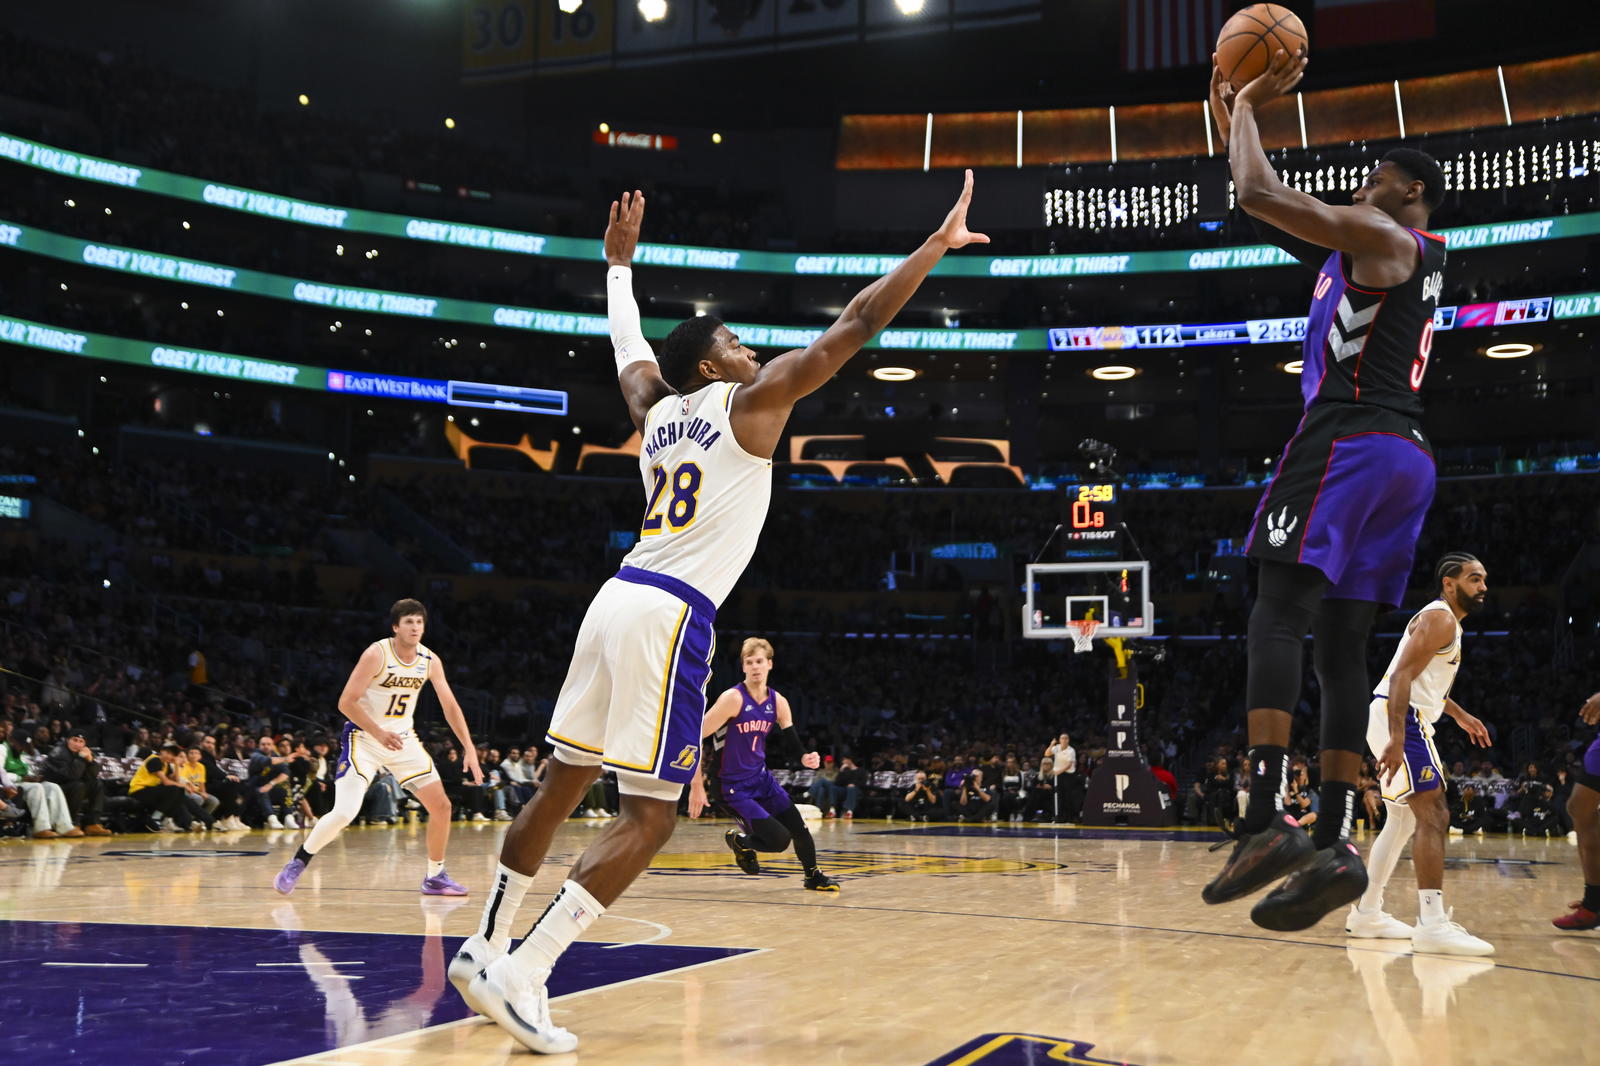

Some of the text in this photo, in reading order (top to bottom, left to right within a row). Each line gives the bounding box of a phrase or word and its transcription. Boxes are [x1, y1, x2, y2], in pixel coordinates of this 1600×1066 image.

[32, 145, 79, 174] YOUR
[79, 157, 142, 187] THIRST
[203, 184, 348, 228] OBEY YOUR THIRST
[406, 219, 546, 254] OBEY YOUR THIRST
[1490, 220, 1553, 244] THIRST
[83, 245, 237, 287] OBEY YOUR THIRST
[643, 245, 686, 264] YOUR
[686, 248, 740, 269] THIRST
[795, 256, 837, 274] OBEY
[836, 256, 878, 274] YOUR
[990, 255, 1130, 276] OBEY YOUR THIRST
[1189, 250, 1233, 270] OBEY
[1232, 247, 1277, 267] YOUR
[294, 282, 438, 316] OBEY YOUR THIRST
[494, 307, 535, 328] OBEY
[534, 312, 576, 332] YOUR
[1258, 319, 1306, 340] 2:58
[27, 325, 87, 353] THIRST
[880, 331, 1018, 350] OBEY YOUR THIRST
[1140, 327, 1178, 346] 112
[1195, 328, 1237, 340] Lakers
[151, 347, 299, 385] OBEY YOUR THIRST
[1409, 318, 1434, 392] 9
[345, 374, 447, 400] EAST WEST BANK
[645, 416, 722, 459] HACHIURA
[641, 461, 704, 537] 28
[1079, 484, 1113, 502] 2:58
[1073, 501, 1105, 528] 0.8
[1081, 530, 1116, 540] TISSOT
[379, 672, 425, 690] LAKERS
[384, 694, 411, 718] 15
[736, 719, 772, 734] TORONT
